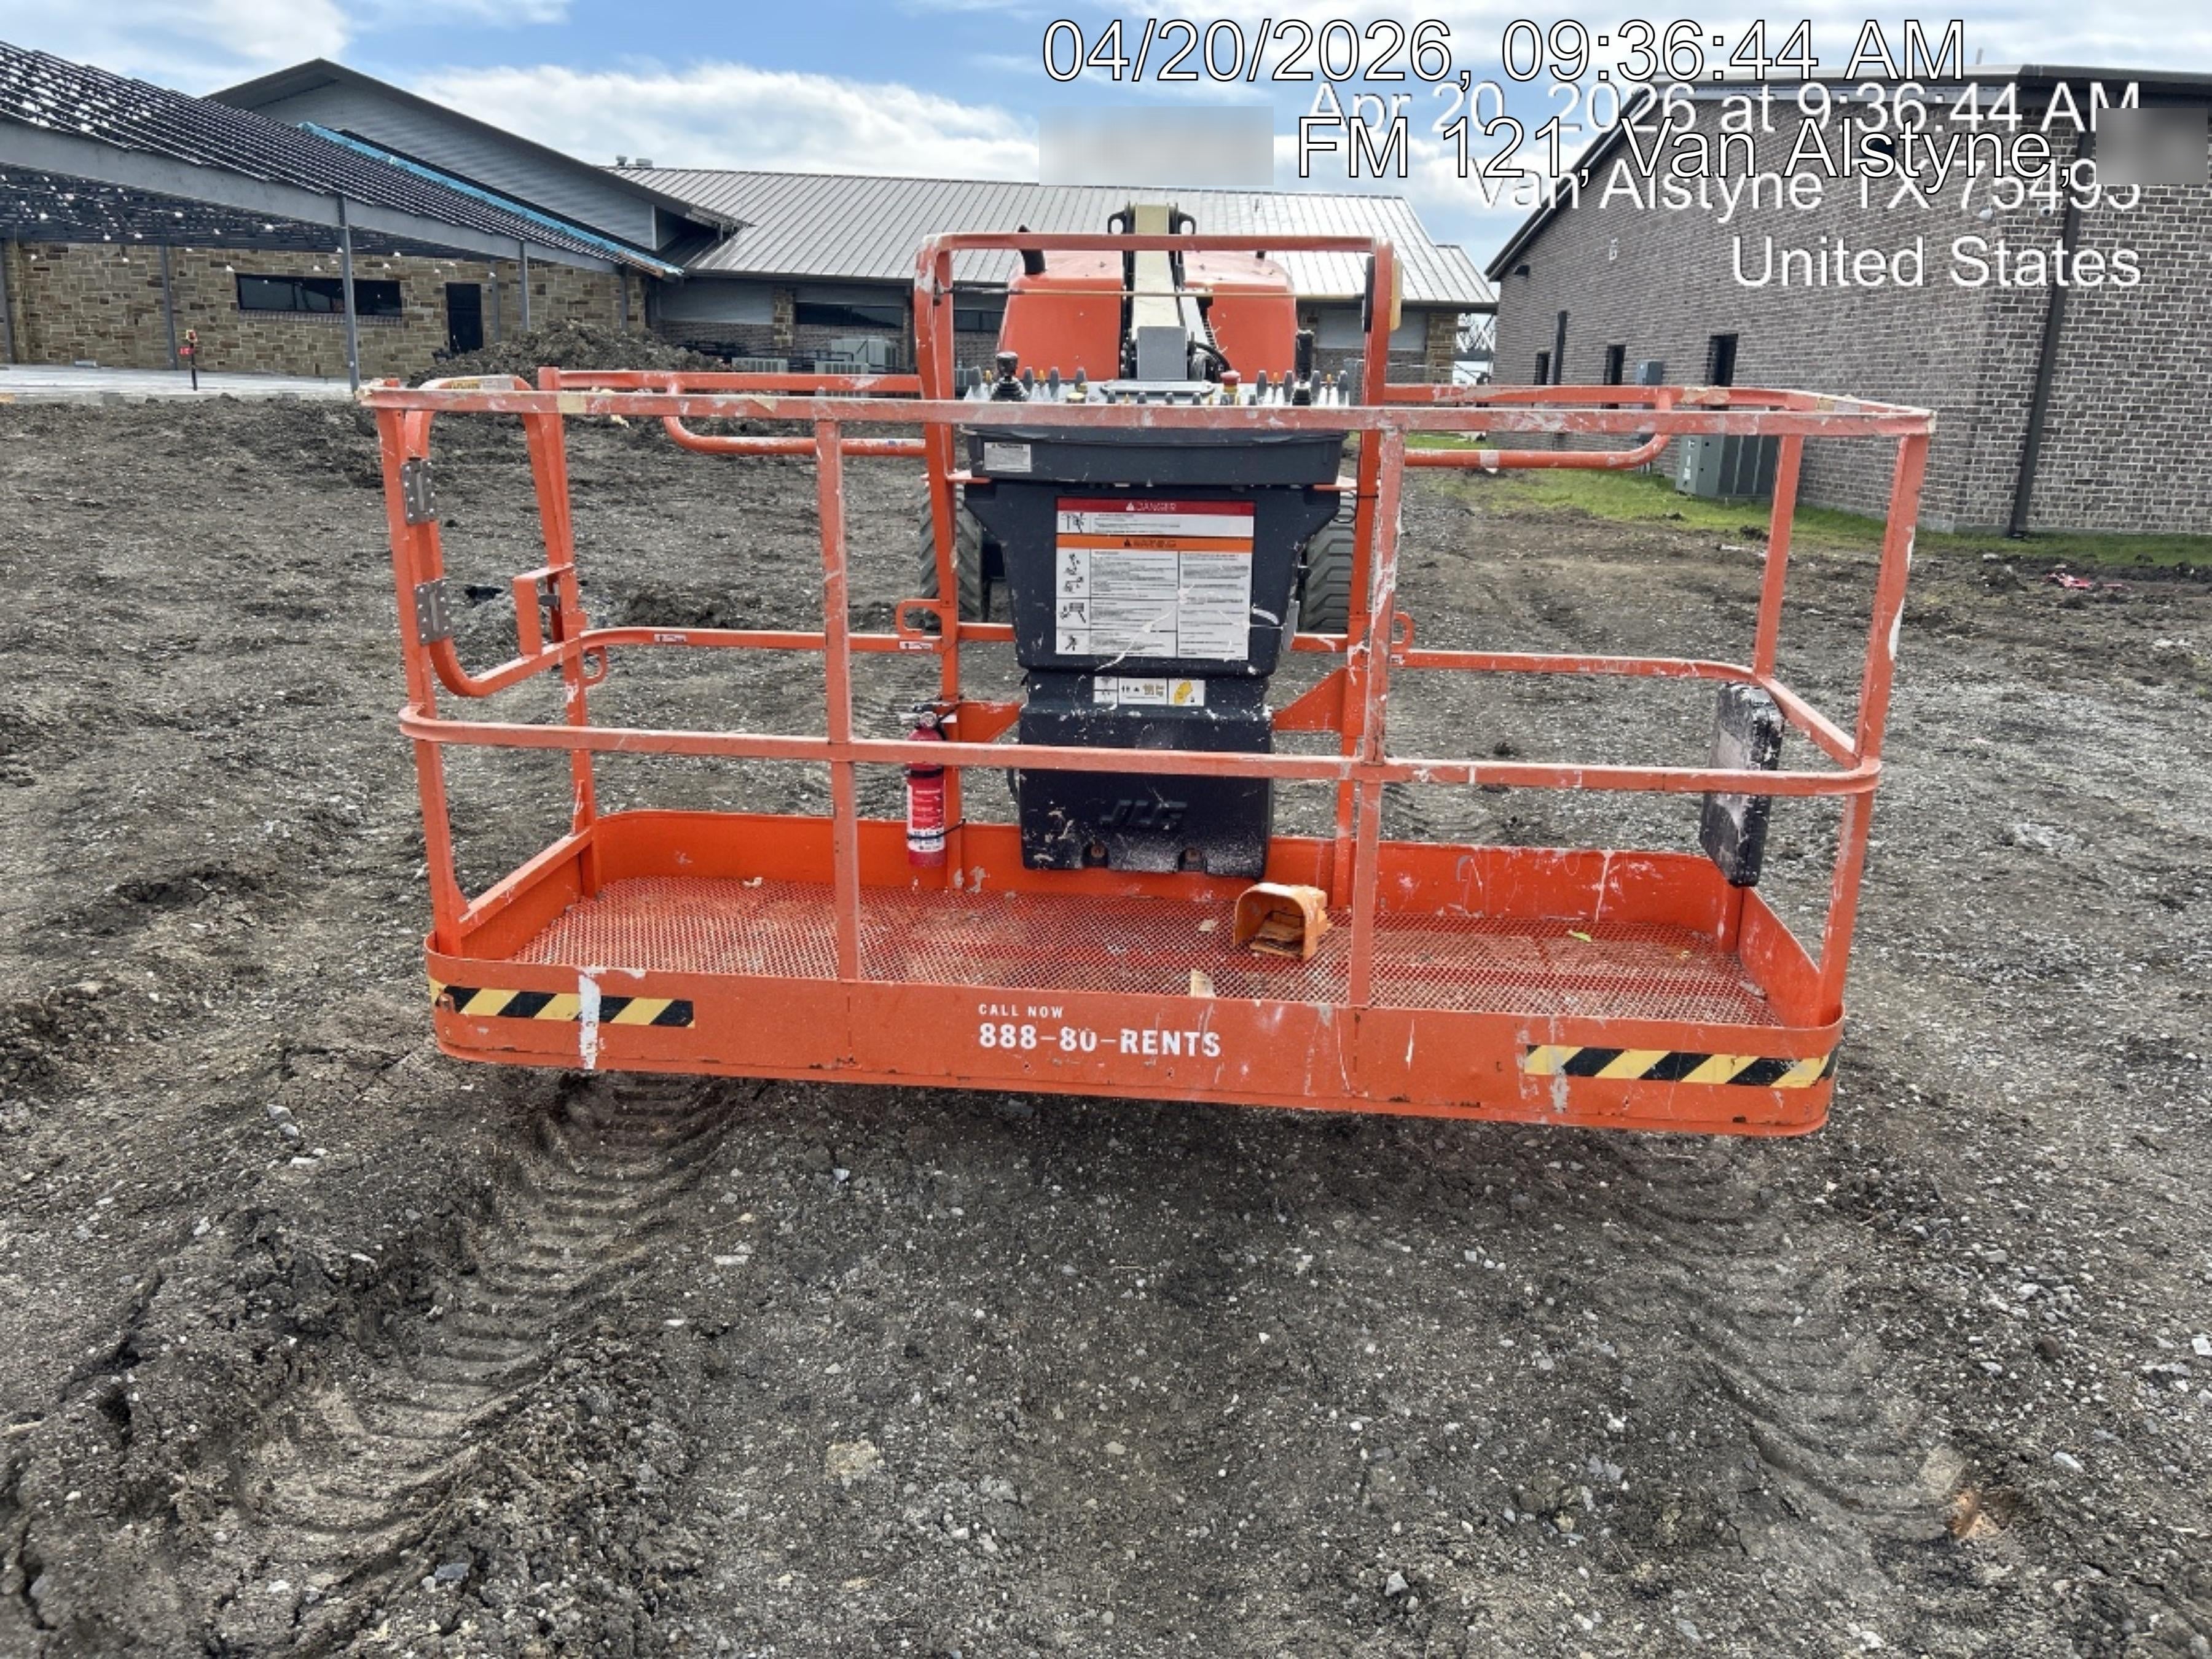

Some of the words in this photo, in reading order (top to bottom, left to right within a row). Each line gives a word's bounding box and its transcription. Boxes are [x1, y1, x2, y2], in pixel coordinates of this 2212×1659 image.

[978, 1004, 1019, 1017] CALL
[1027, 1006, 1064, 1018] NOW
[979, 1022, 1221, 1057] 888-80-RENTS
